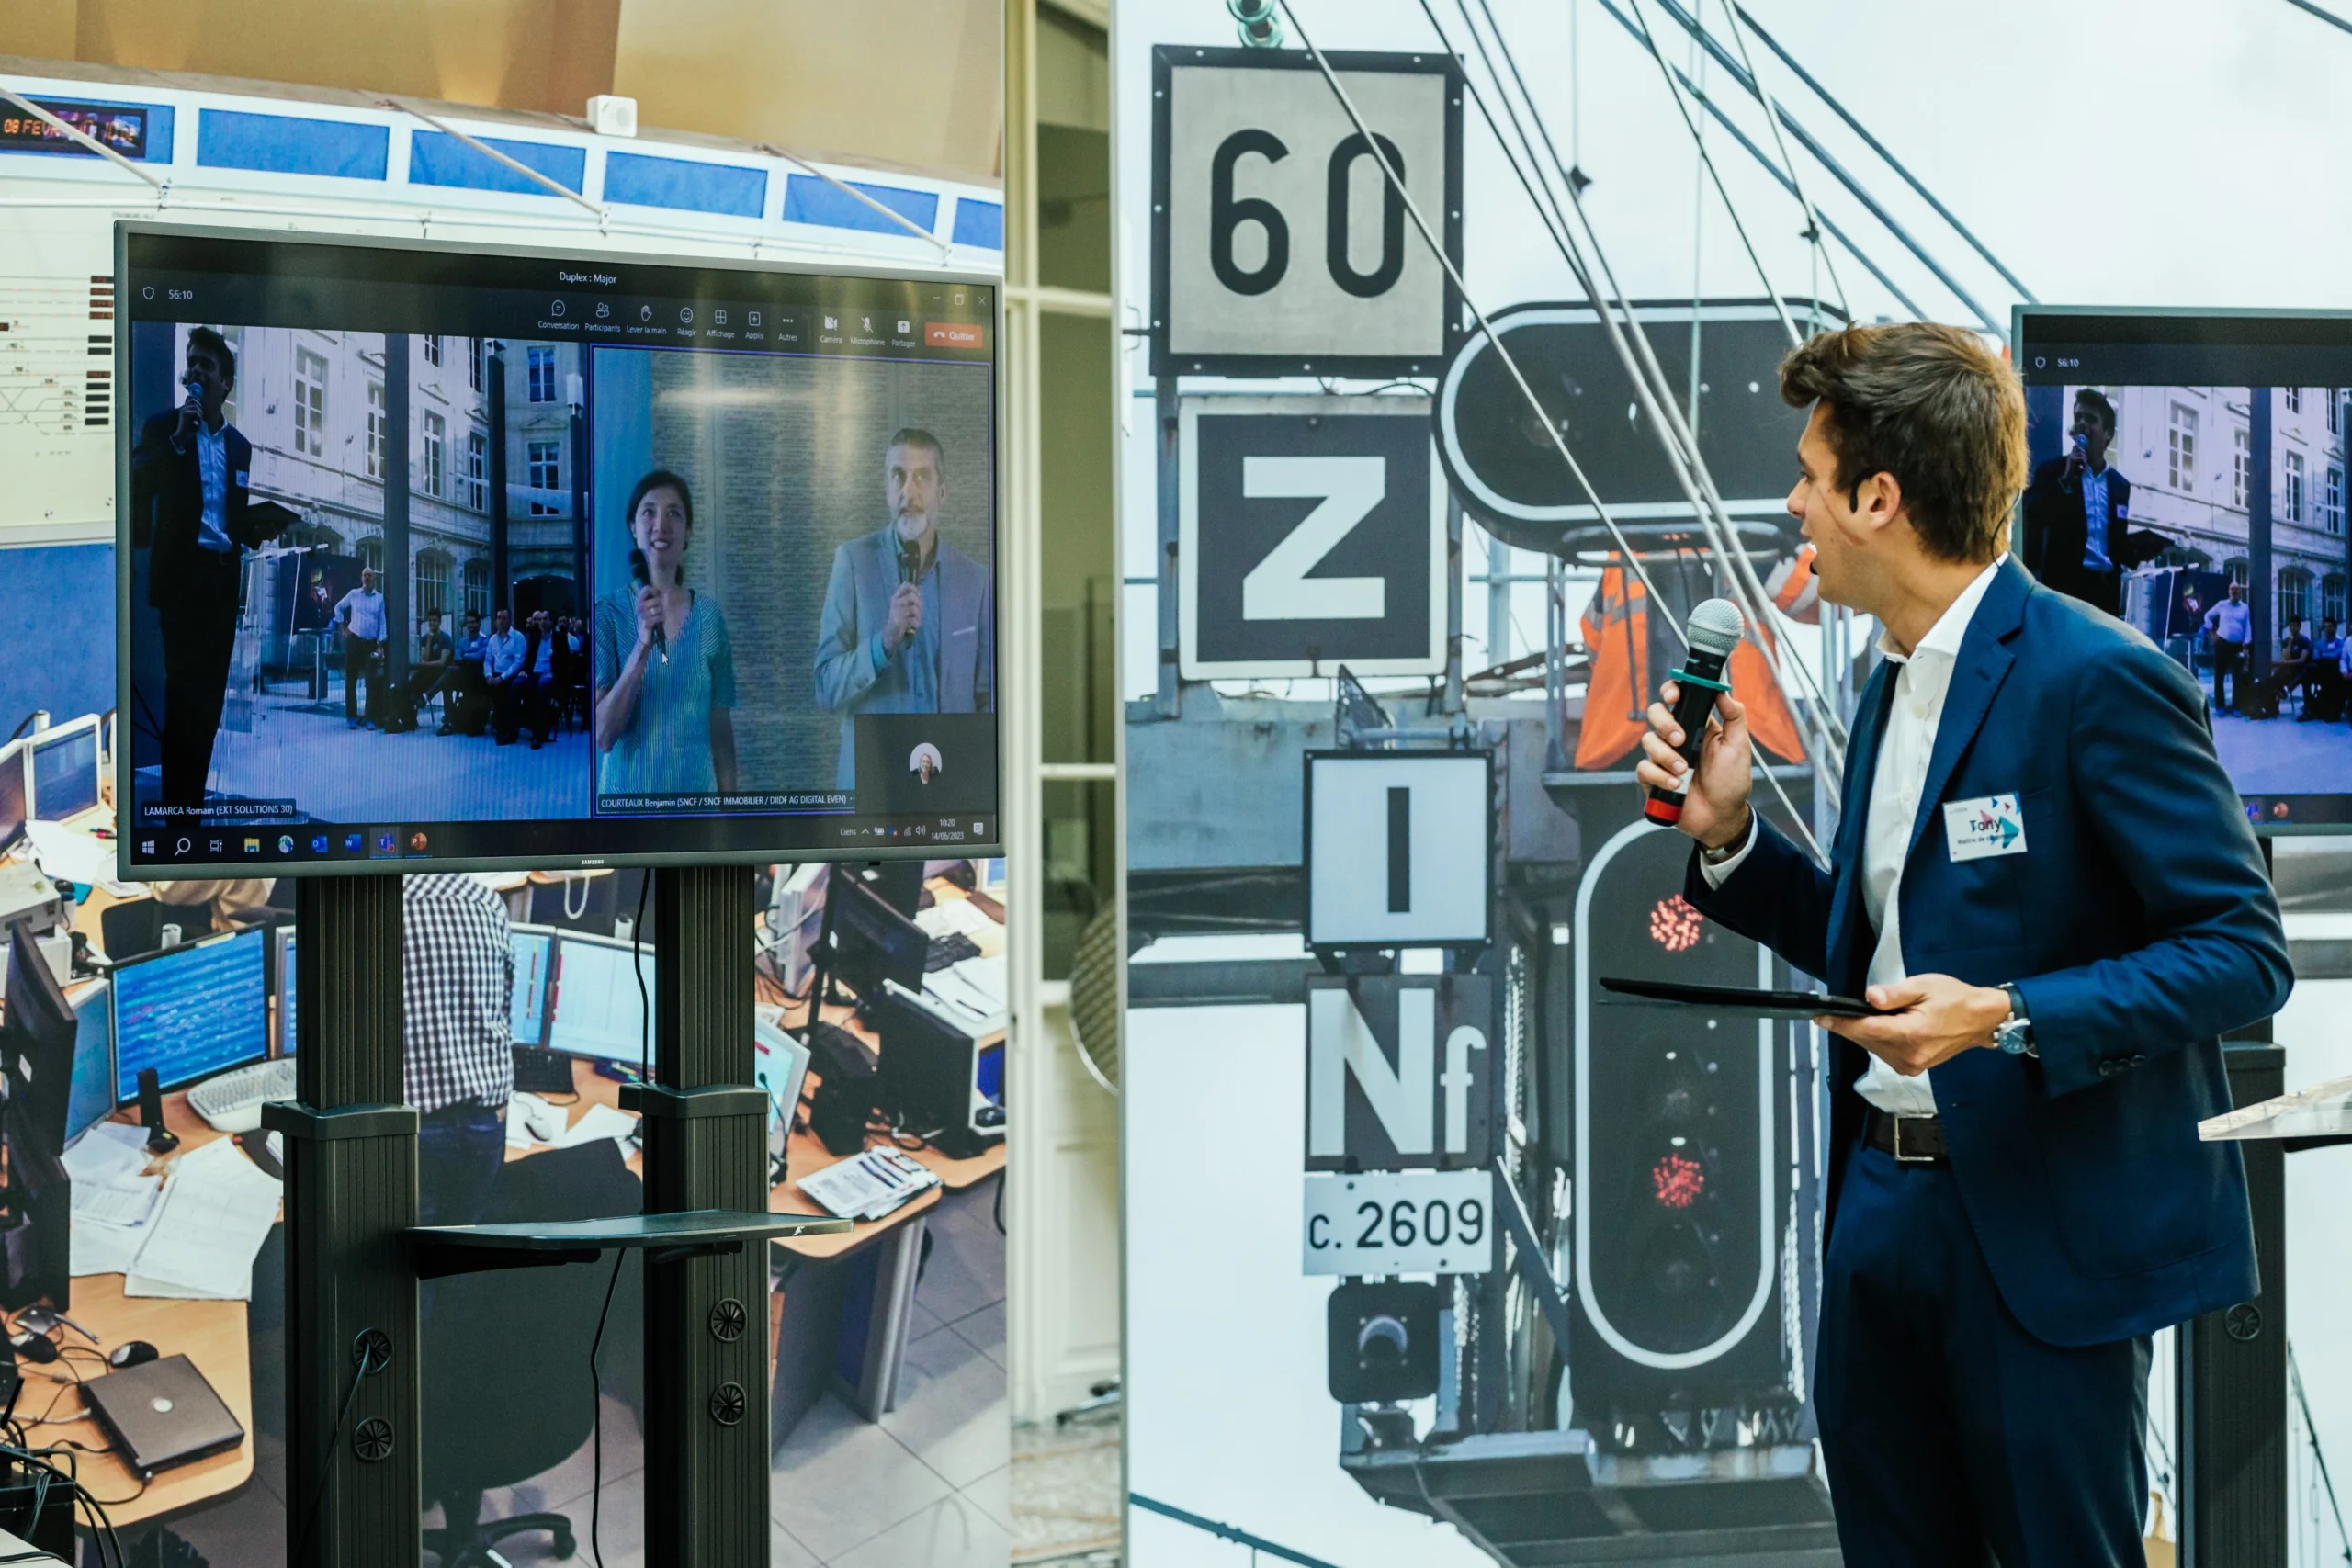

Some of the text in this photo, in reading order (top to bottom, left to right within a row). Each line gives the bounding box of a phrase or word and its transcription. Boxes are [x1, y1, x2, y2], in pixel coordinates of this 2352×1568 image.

[1209, 128, 1406, 298] 60
[560, 272, 588, 283] Duplex
[594, 275, 616, 285] Major
[168, 289, 193, 299] 56:10
[537, 321, 580, 331] Conversation
[584, 322, 621, 333] Participants
[627, 325, 667, 335] Lever la main
[677, 327, 696, 337] Réagir
[707, 329, 735, 339] Affichage
[745, 332, 764, 341] Applis
[948, 331, 976, 341] Quitter
[778, 333, 798, 342] Autres
[820, 334, 842, 344] Caméra
[850, 336, 886, 346] Microphone
[891, 338, 916, 348] Partager
[2058, 358, 2079, 367] 56:10
[1242, 456, 1386, 620] Z
[601, 798, 643, 807] COURTEAUX
[645, 798, 675, 808] Benjamin
[677, 797, 697, 807] (SNCF
[704, 796, 721, 806] SNCF
[723, 796, 763, 806] IMMOBILIER
[789, 795, 798, 804] AG
[800, 795, 825, 804] DIGITAL
[827, 795, 847, 805] EVEN)
[144, 805, 293, 816] LAMARCA Romain (EXT SOLUTIONS 30)
[939, 818, 956, 827] 10:20
[1969, 818, 2002, 833] Tony
[841, 828, 856, 836] Liens
[932, 831, 964, 840] 14/06/2023
[1309, 987, 1487, 1156] Nf
